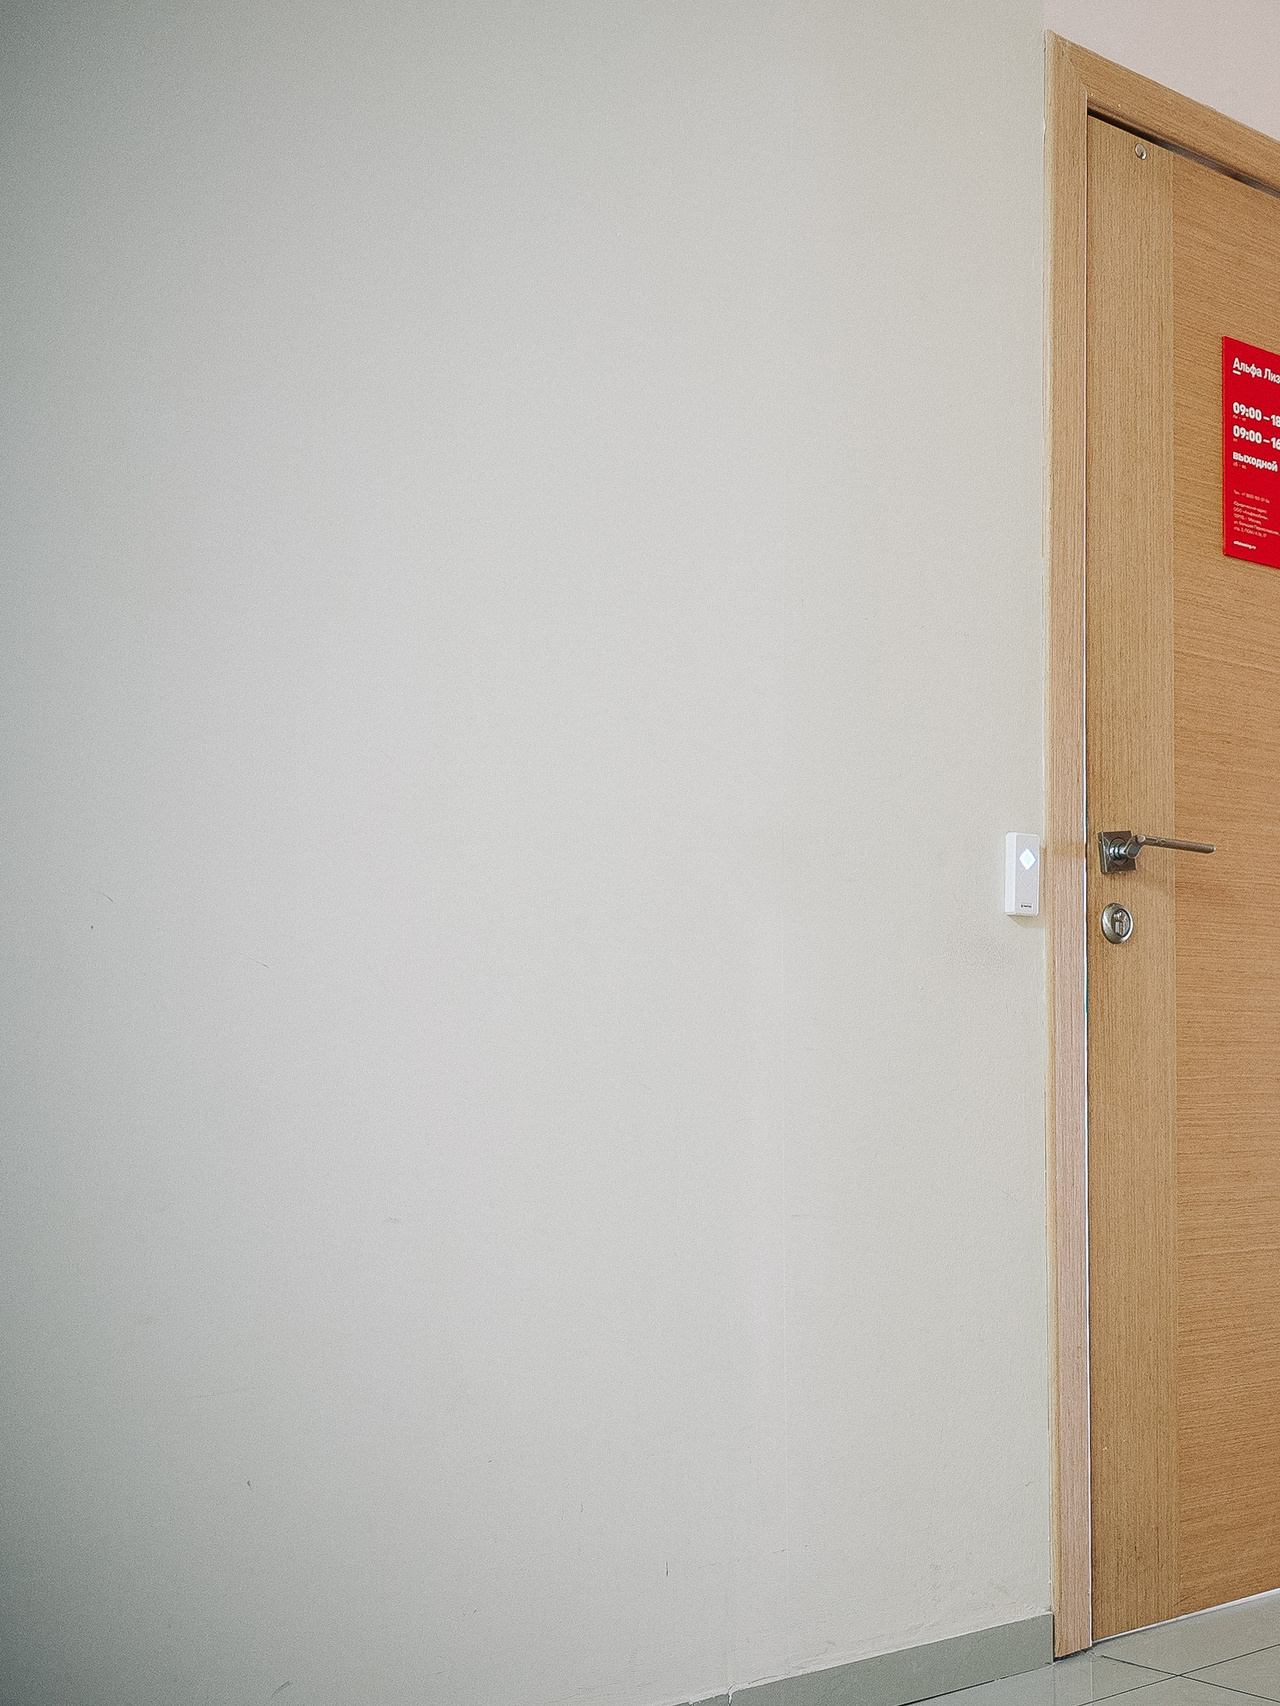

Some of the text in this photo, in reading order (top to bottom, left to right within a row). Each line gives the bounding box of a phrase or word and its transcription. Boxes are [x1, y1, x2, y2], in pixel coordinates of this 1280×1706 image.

[1233, 357, 1262, 379] Альфа
[1232, 401, 1262, 421] 09:00
[1232, 425, 1262, 444] 09:00
[1232, 451, 1279, 472] выходной
